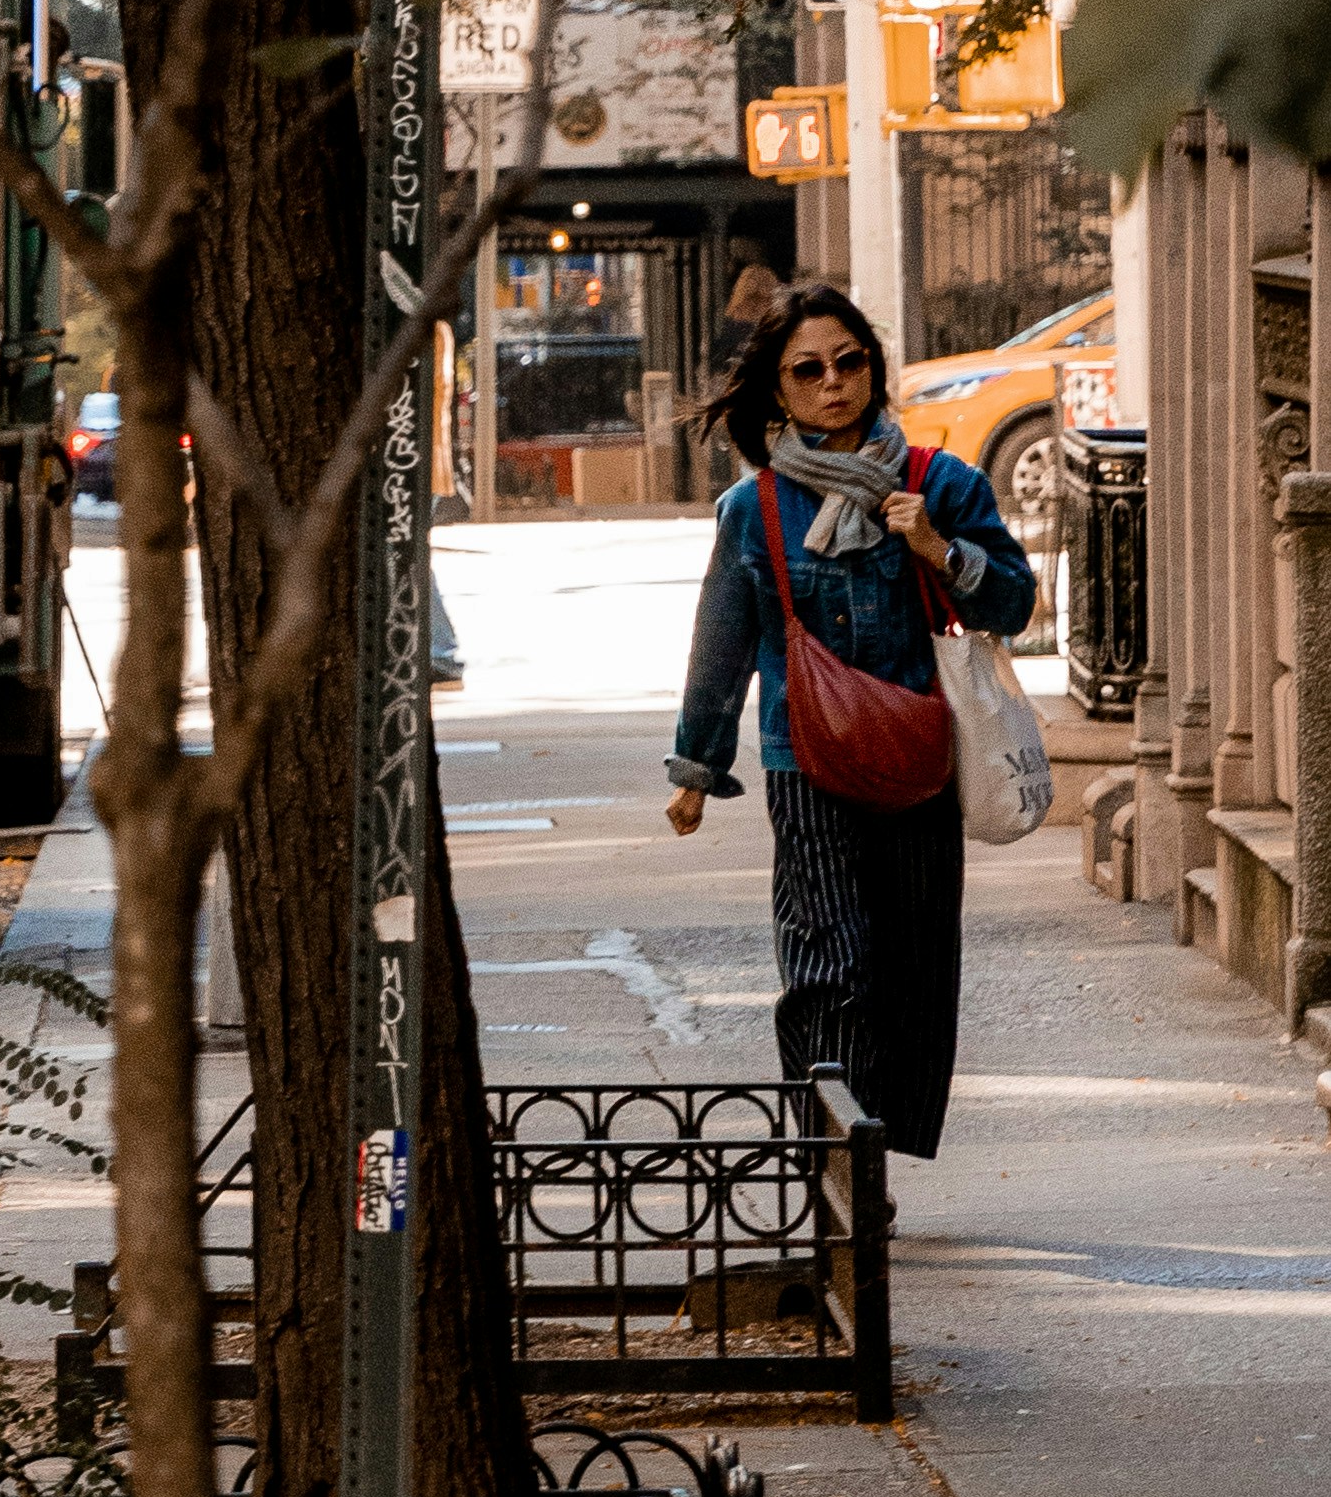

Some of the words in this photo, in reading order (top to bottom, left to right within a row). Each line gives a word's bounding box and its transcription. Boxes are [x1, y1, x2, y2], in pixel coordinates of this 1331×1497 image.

[454, 22, 521, 52] RED
[798, 114, 821, 161] 6
[392, 1157, 408, 1210] HELLO
